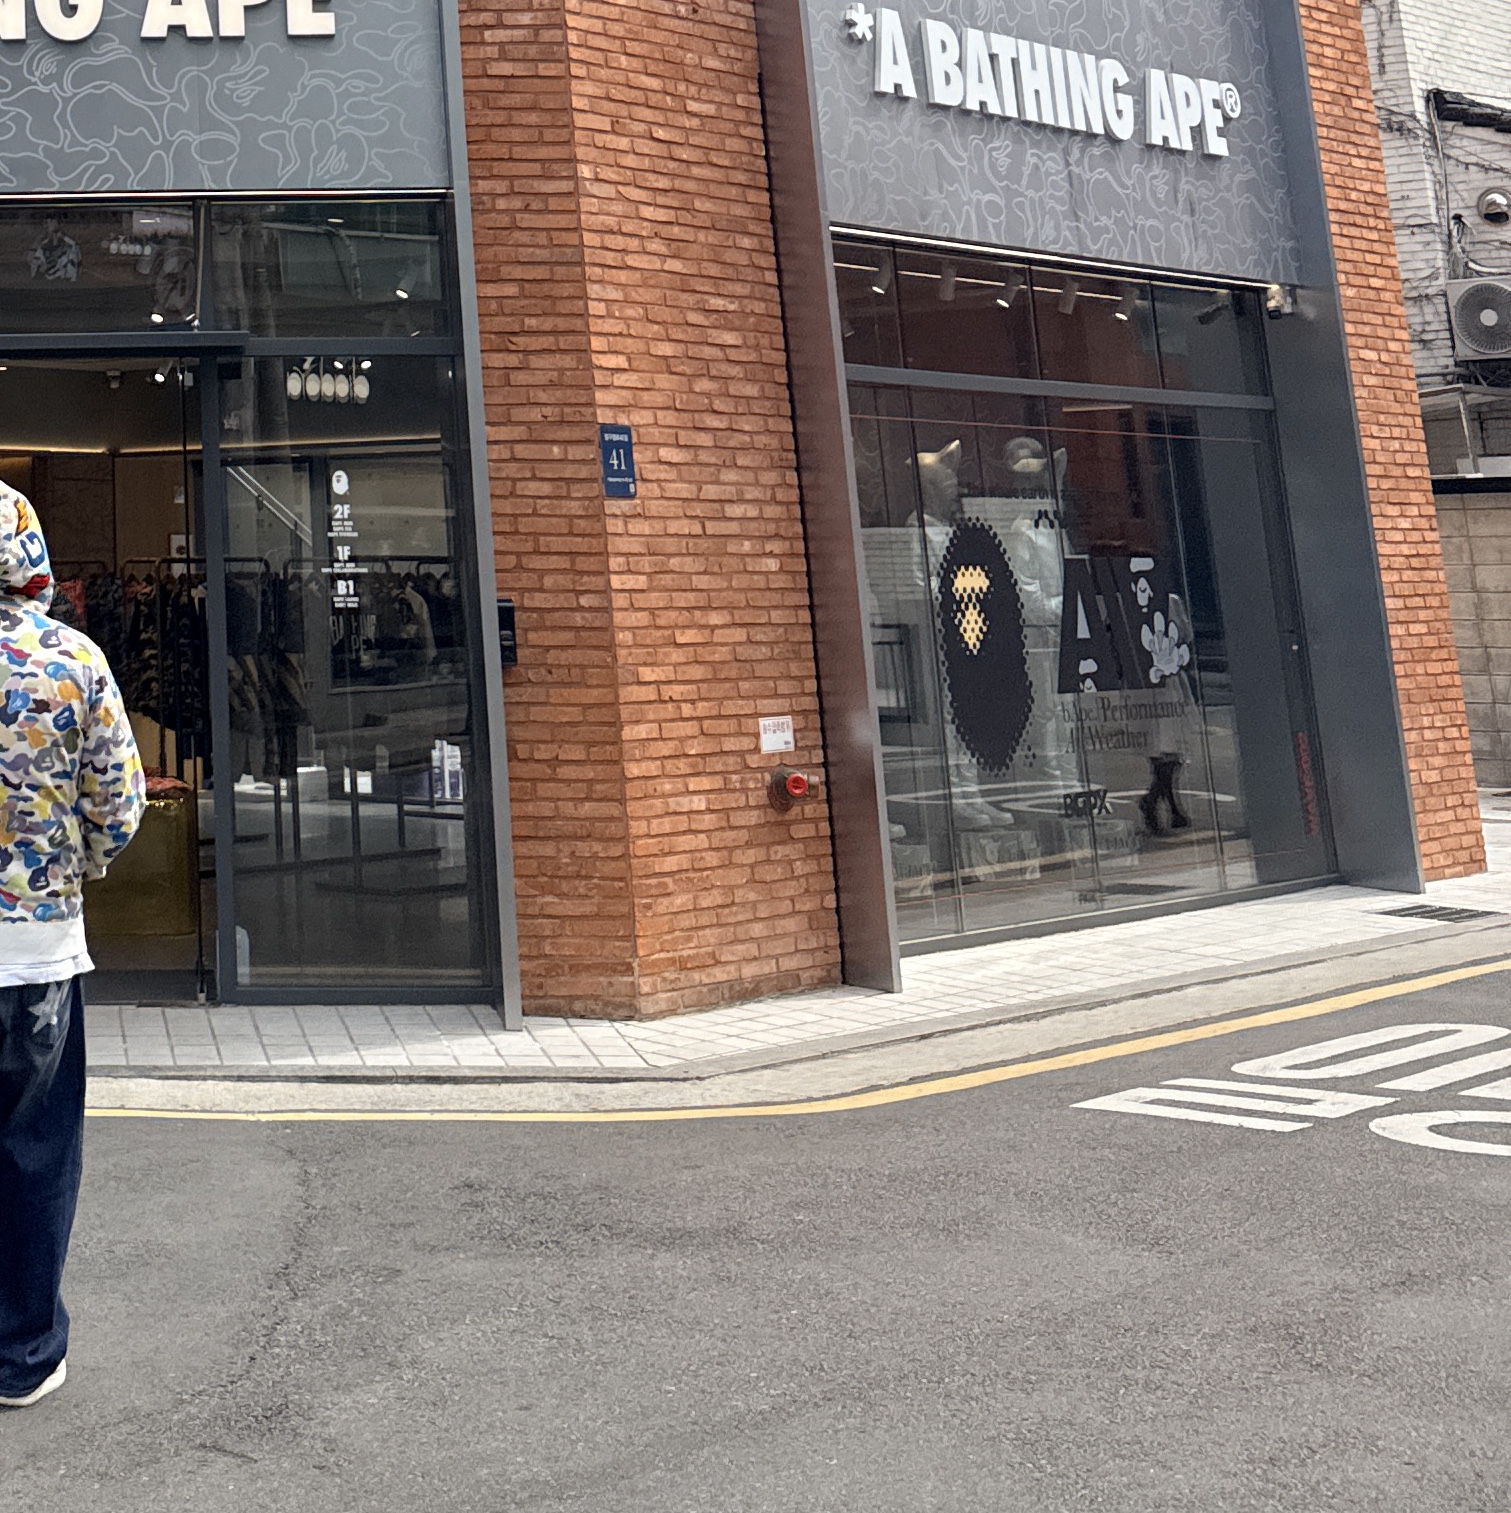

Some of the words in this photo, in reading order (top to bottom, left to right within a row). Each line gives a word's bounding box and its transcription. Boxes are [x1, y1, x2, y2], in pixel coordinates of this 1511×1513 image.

[919, 17, 1135, 142] BATHING
[608, 448, 627, 470] 41
[333, 503, 351, 519] 2F
[336, 545, 351, 561] 1F
[336, 579, 355, 596] B1
